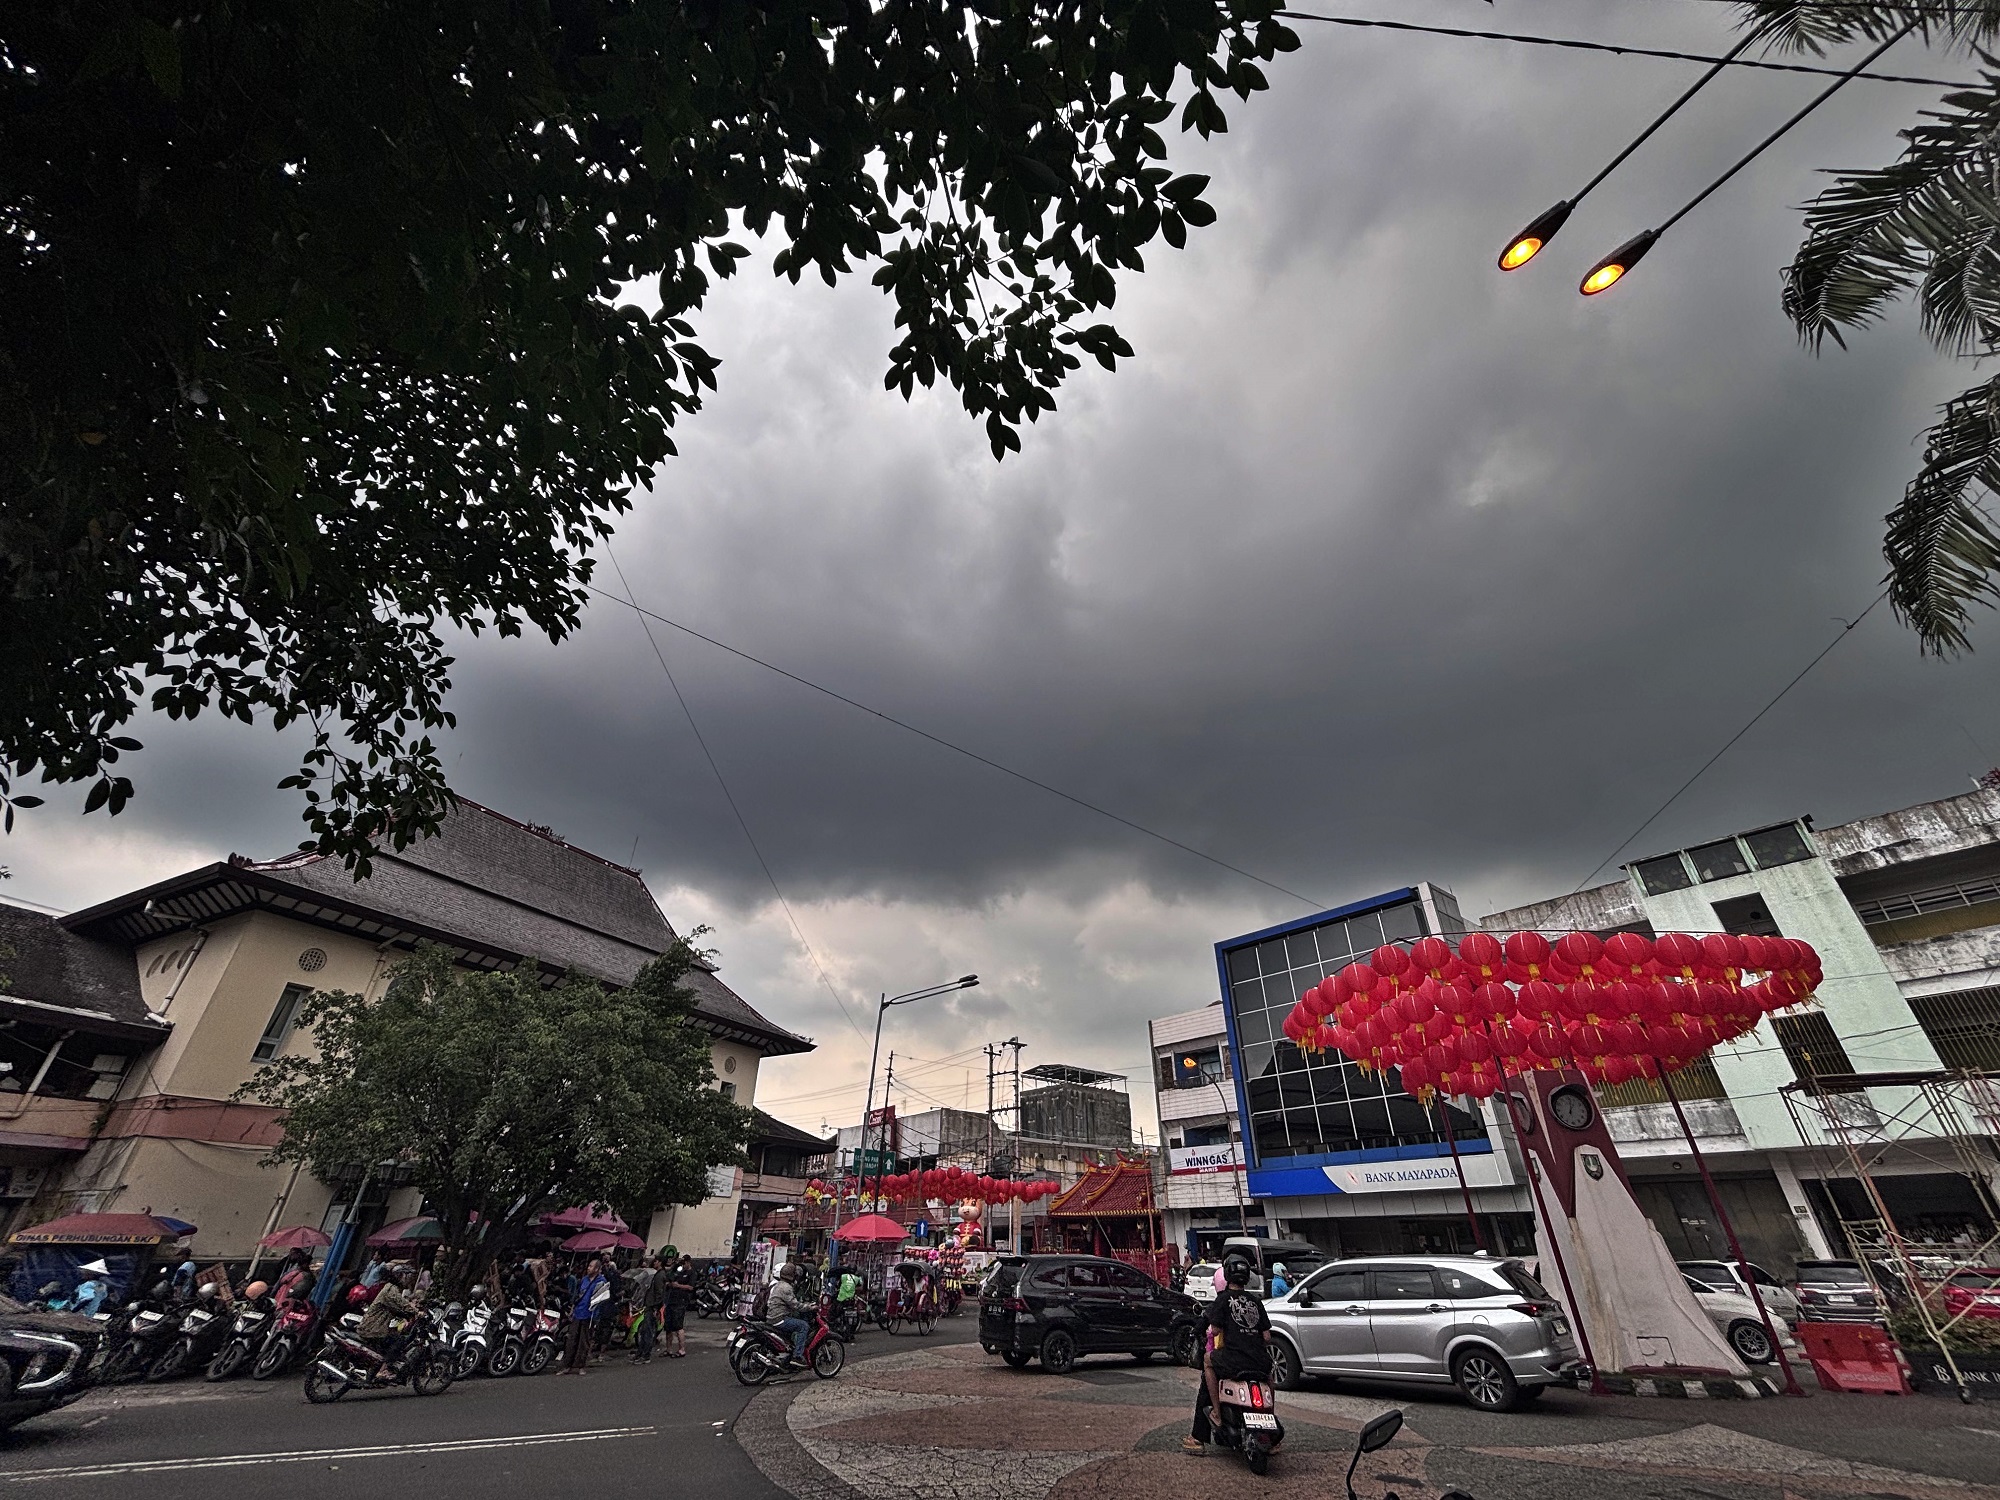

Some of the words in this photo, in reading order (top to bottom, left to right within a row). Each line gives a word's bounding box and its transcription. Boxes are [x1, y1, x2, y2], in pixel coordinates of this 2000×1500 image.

[1365, 1172, 1396, 1183] BANK
[1397, 1167, 1459, 1181] MAYAPADA
[52, 1234, 132, 1243] PERHUBUNGAN
